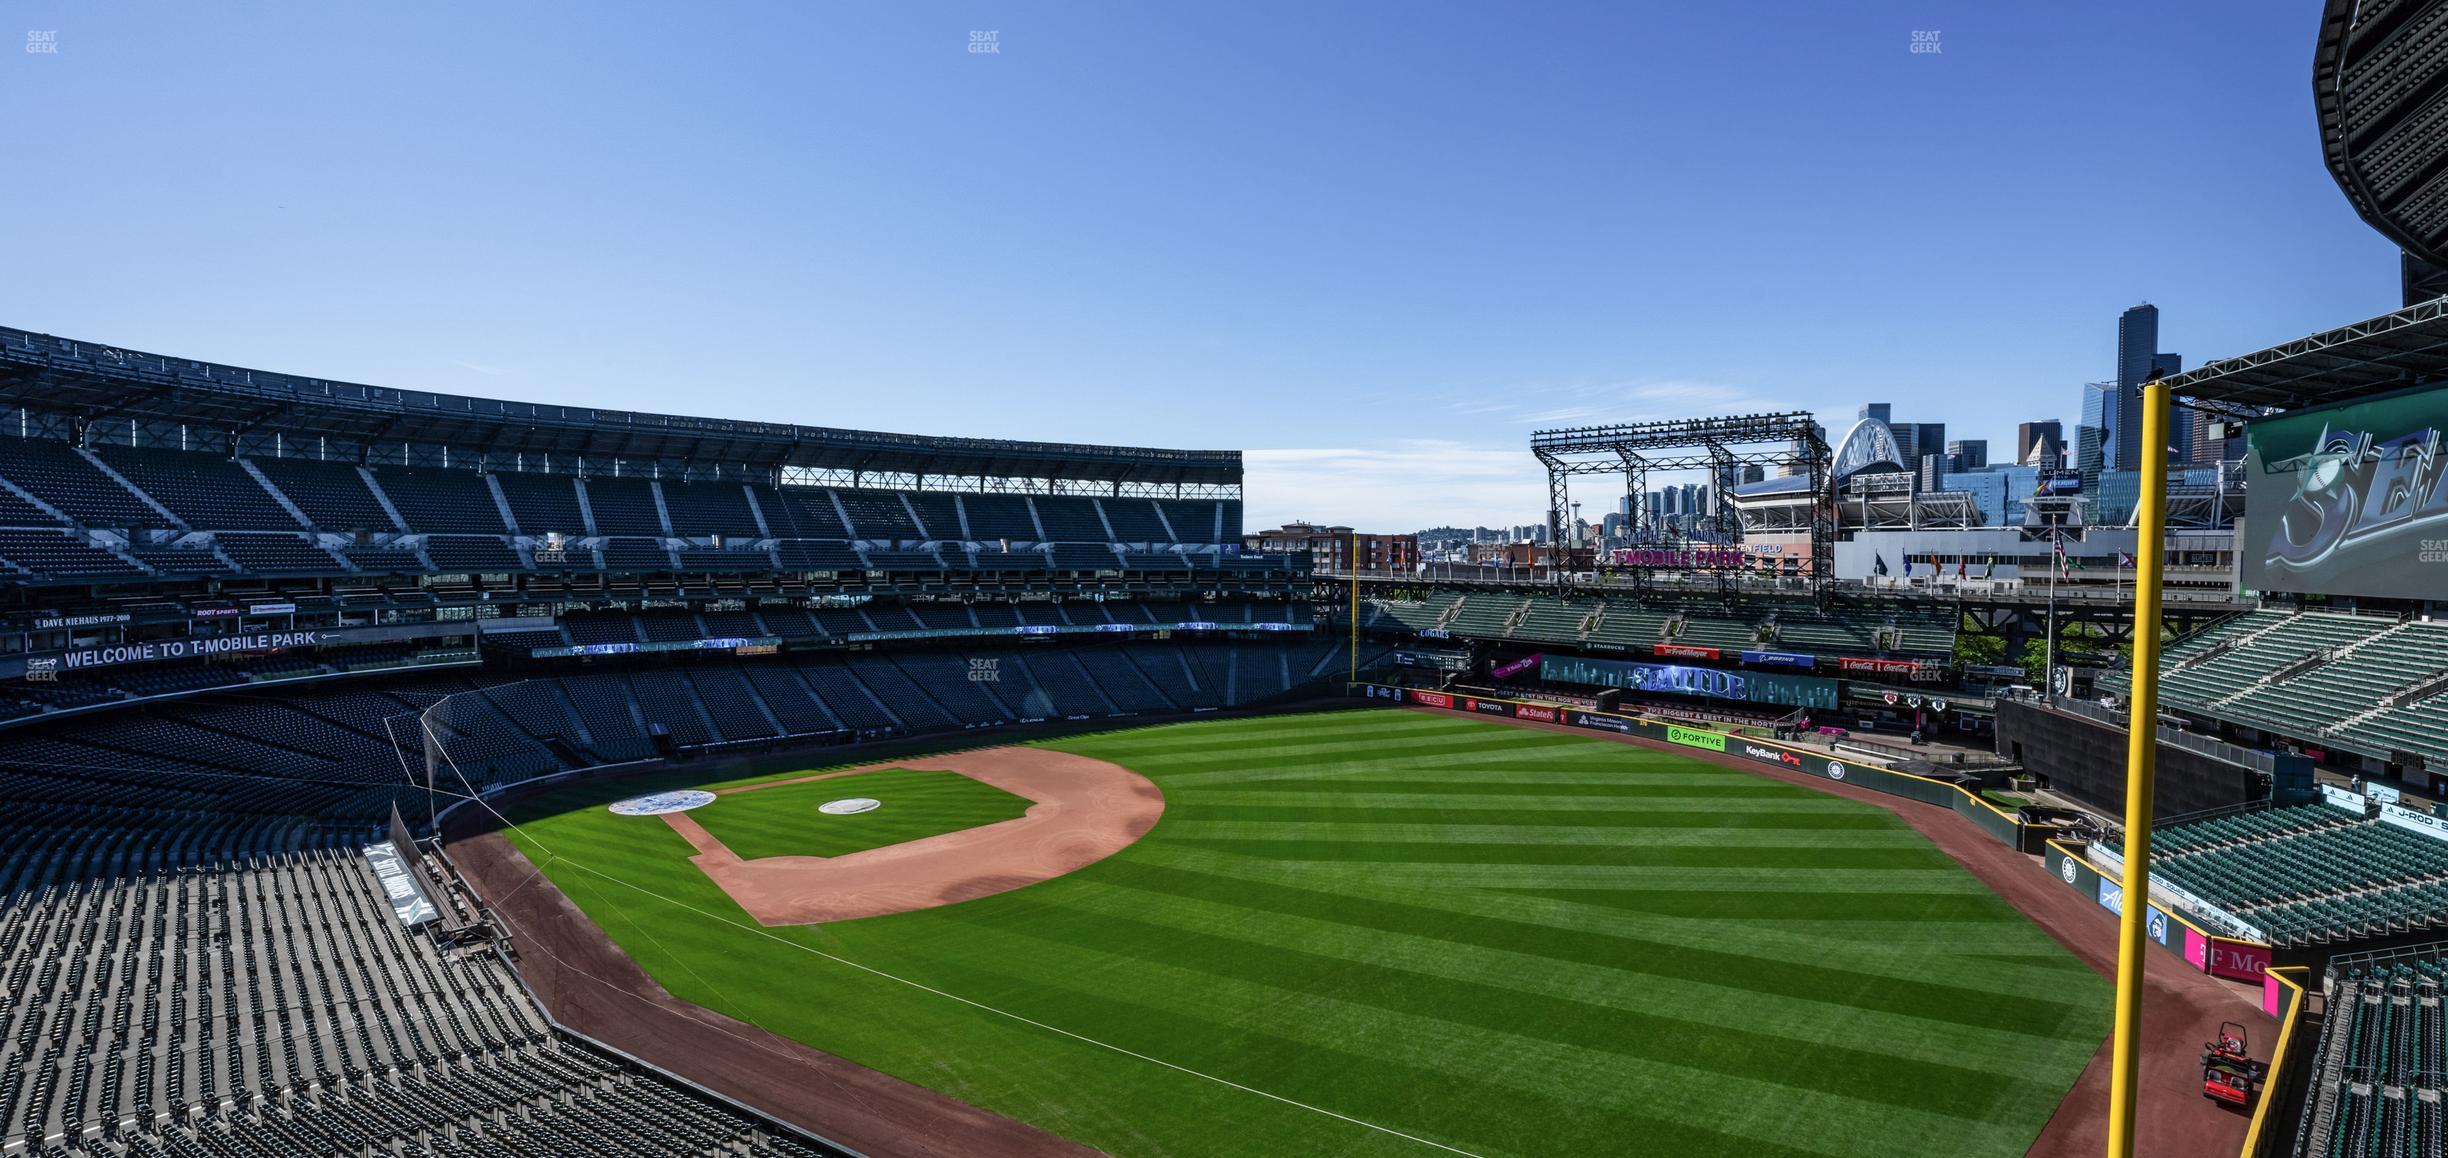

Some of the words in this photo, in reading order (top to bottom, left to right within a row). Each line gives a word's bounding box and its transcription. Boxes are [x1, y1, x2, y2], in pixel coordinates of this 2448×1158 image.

[1752, 544, 1782, 553] FIELD
[1613, 549, 1691, 567] T-MOBILE
[1695, 549, 1745, 567] PARK
[42, 618, 64, 628] DAVE
[65, 615, 99, 626] NIEHAUS
[64, 645, 155, 669] WELCOME
[160, 641, 185, 657] TO
[190, 634, 268, 654] T-MOBILE
[272, 631, 317, 647] PARK
[1593, 643, 1625, 651] STARBUCKS
[1478, 702, 1503, 711] TOYOTA
[1663, 709, 1695, 719] BIGGEST
[1702, 714, 1723, 723] BEST
[1723, 716, 1733, 724] IN
[1733, 717, 1749, 725] THE
[1683, 733, 1722, 747] FORTIVE
[1746, 745, 1781, 761] KeyBank
[2398, 810, 2433, 825] J-ROD
